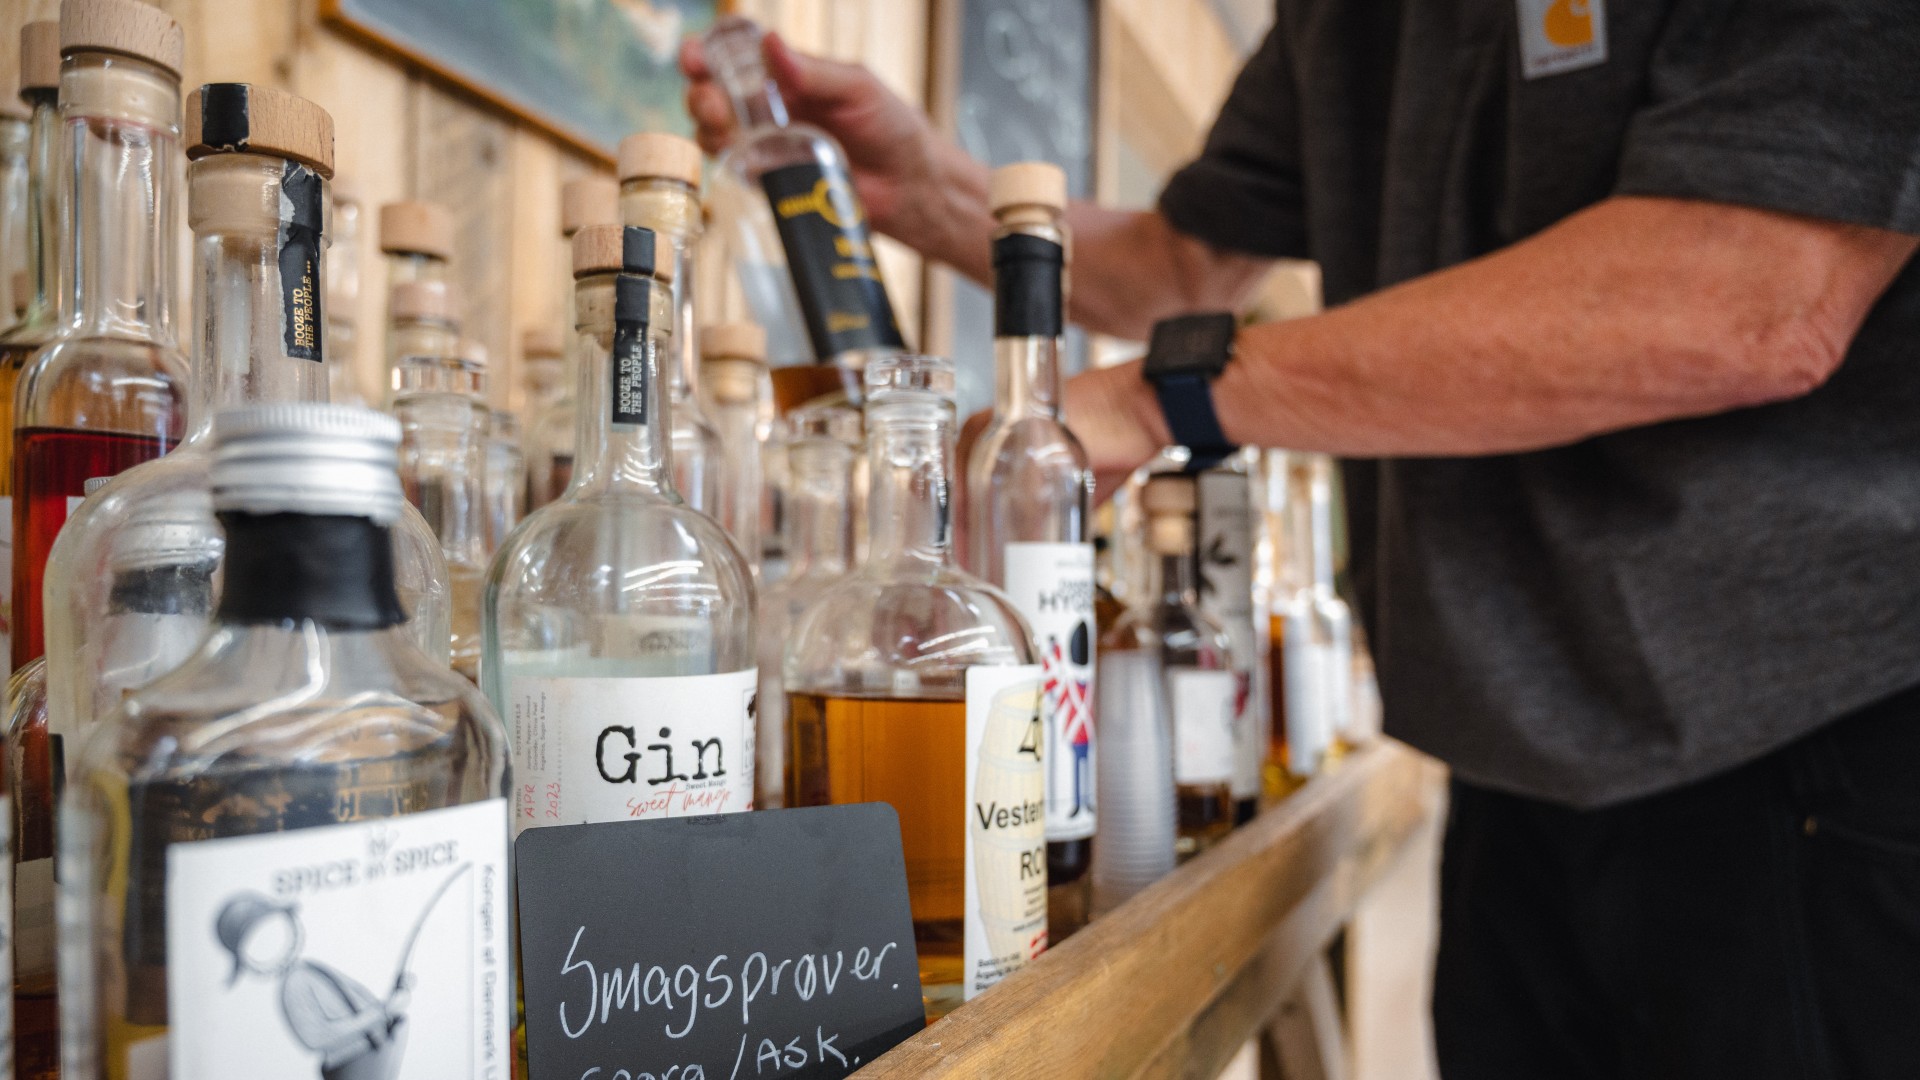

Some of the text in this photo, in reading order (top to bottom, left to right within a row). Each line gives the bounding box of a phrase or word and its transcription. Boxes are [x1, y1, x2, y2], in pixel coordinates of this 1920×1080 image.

[292, 287, 305, 347] BOOZE TO
[303, 275, 314, 322] PEOPLE
[305, 324, 314, 348] THE
[619, 358, 632, 414] BOOZE TO
[631, 343, 642, 388] PEOPLE
[631, 391, 642, 415] THE
[596, 725, 727, 785] Gin
[523, 783, 536, 819] APR
[545, 782, 560, 819] 2023
[272, 859, 361, 894] SPICE
[393, 839, 460, 874] SPICE
[560, 926, 899, 1039] Smagsprøver.
